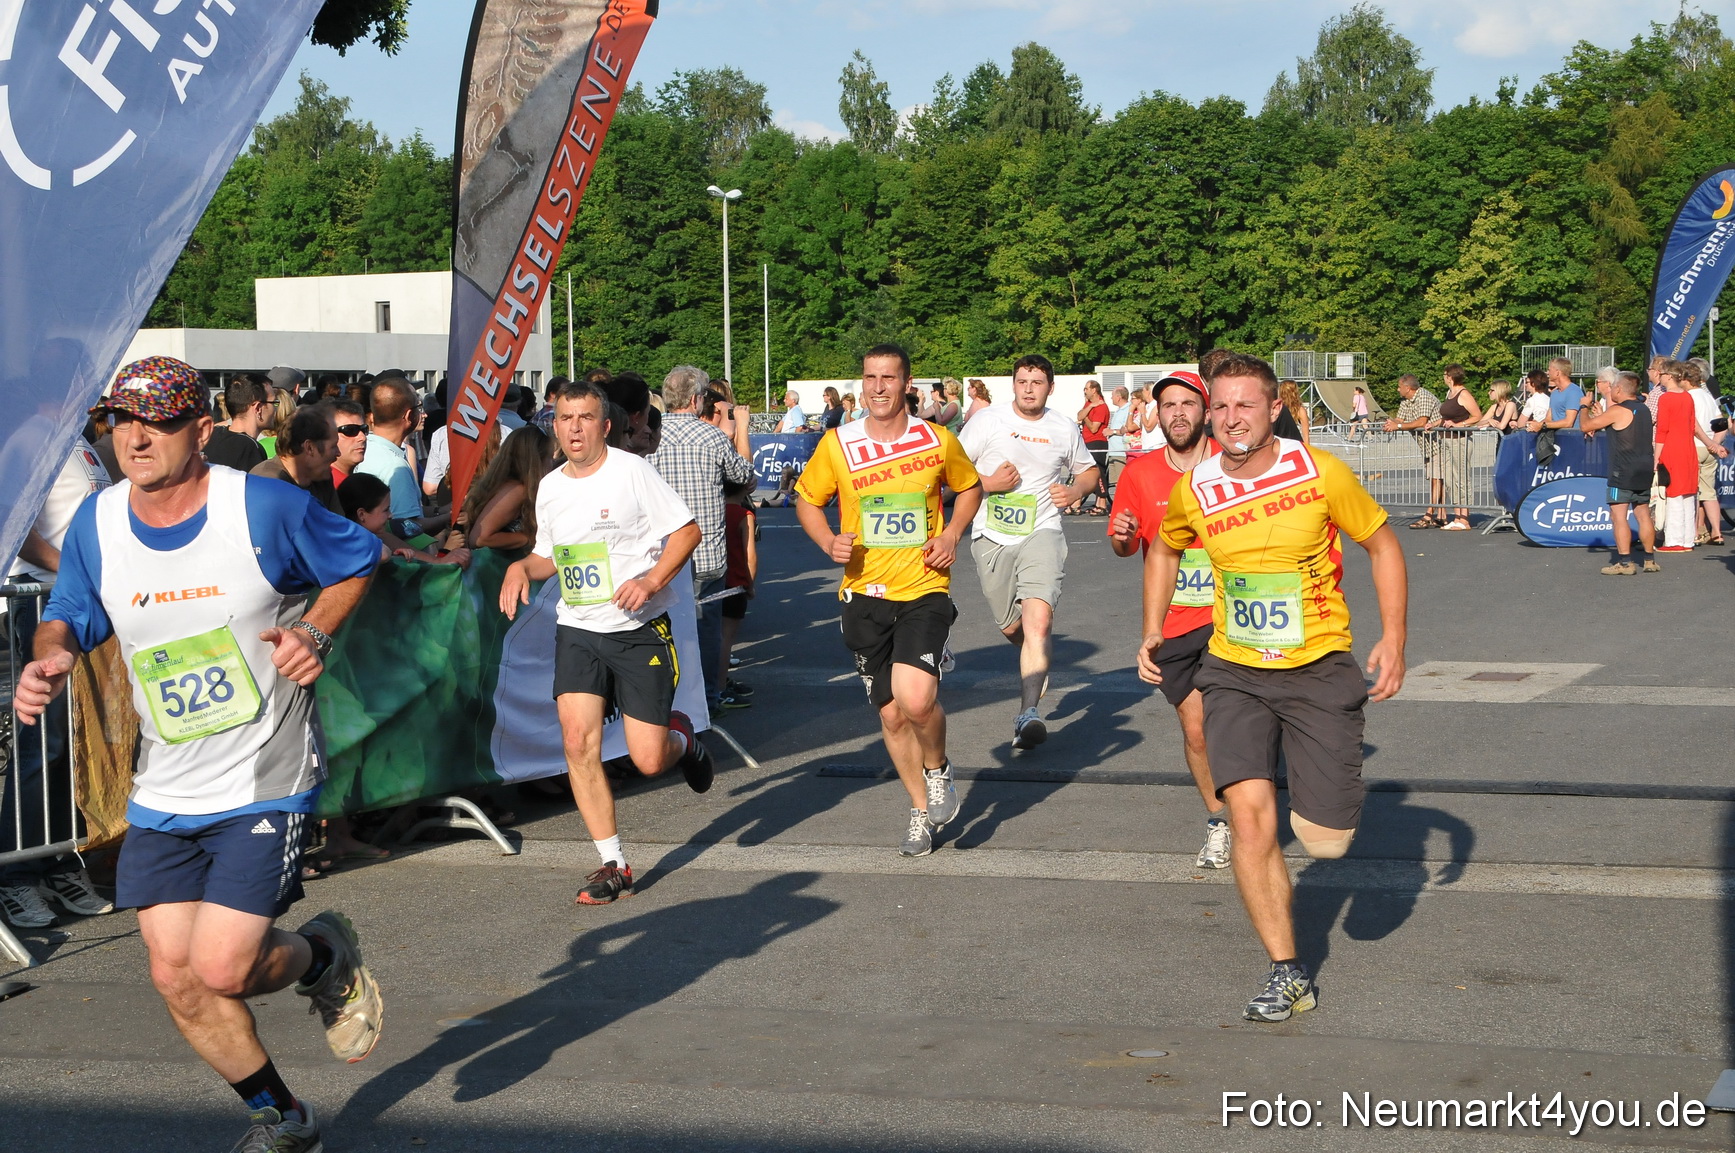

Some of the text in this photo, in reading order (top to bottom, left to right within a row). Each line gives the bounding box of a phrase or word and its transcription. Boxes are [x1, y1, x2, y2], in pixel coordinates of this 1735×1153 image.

[57, 0, 182, 114] Fi
[1656, 221, 1731, 330] Frischmann
[852, 454, 944, 491] MAX BÖGL
[870, 512, 916, 535] 756
[994, 505, 1027, 525] 520
[1206, 487, 1325, 538] MAX BÖGL
[1551, 506, 1633, 524] Fischr
[1559, 523, 1613, 532] AUTOMOB
[563, 564, 601, 590] 896
[154, 585, 226, 603] KLEBL
[1233, 599, 1289, 630] 805
[159, 666, 235, 718] 528
